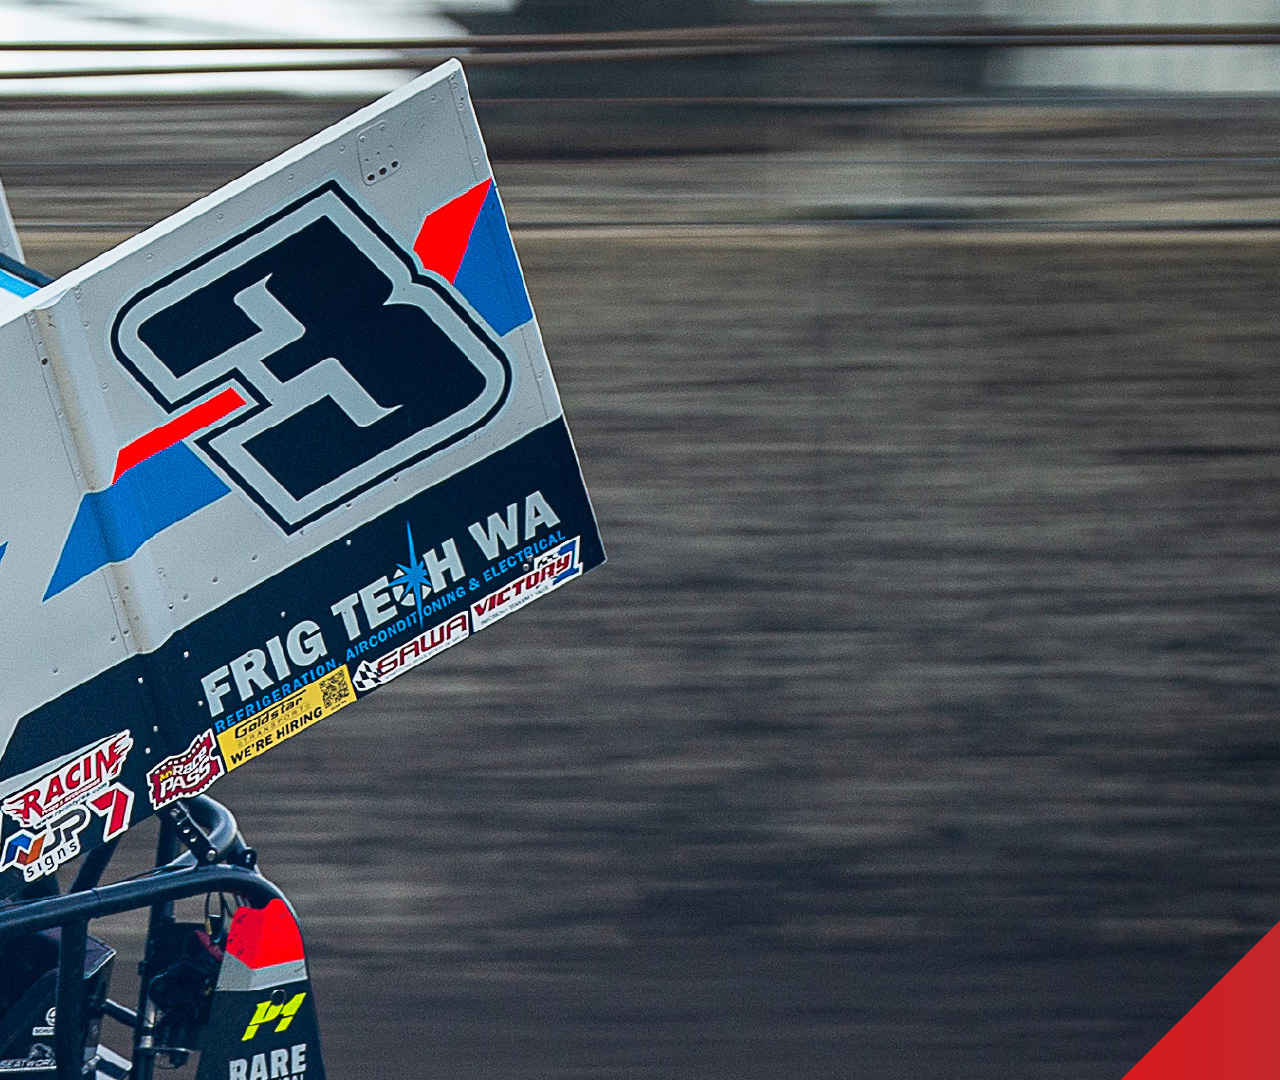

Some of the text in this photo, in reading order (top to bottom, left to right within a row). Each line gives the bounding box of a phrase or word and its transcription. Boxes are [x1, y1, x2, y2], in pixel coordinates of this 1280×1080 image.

[112, 180, 511, 534] 3
[469, 577, 480, 591] &
[483, 530, 566, 582] ELECTRICAL
[473, 553, 571, 617] VICTORY
[200, 620, 328, 718] FRIG
[468, 490, 561, 562] WA
[377, 614, 468, 678] SAWA
[230, 706, 323, 765] WE'RE HIRING
[234, 696, 304, 739] Goldstar
[25, 841, 78, 879] signs
